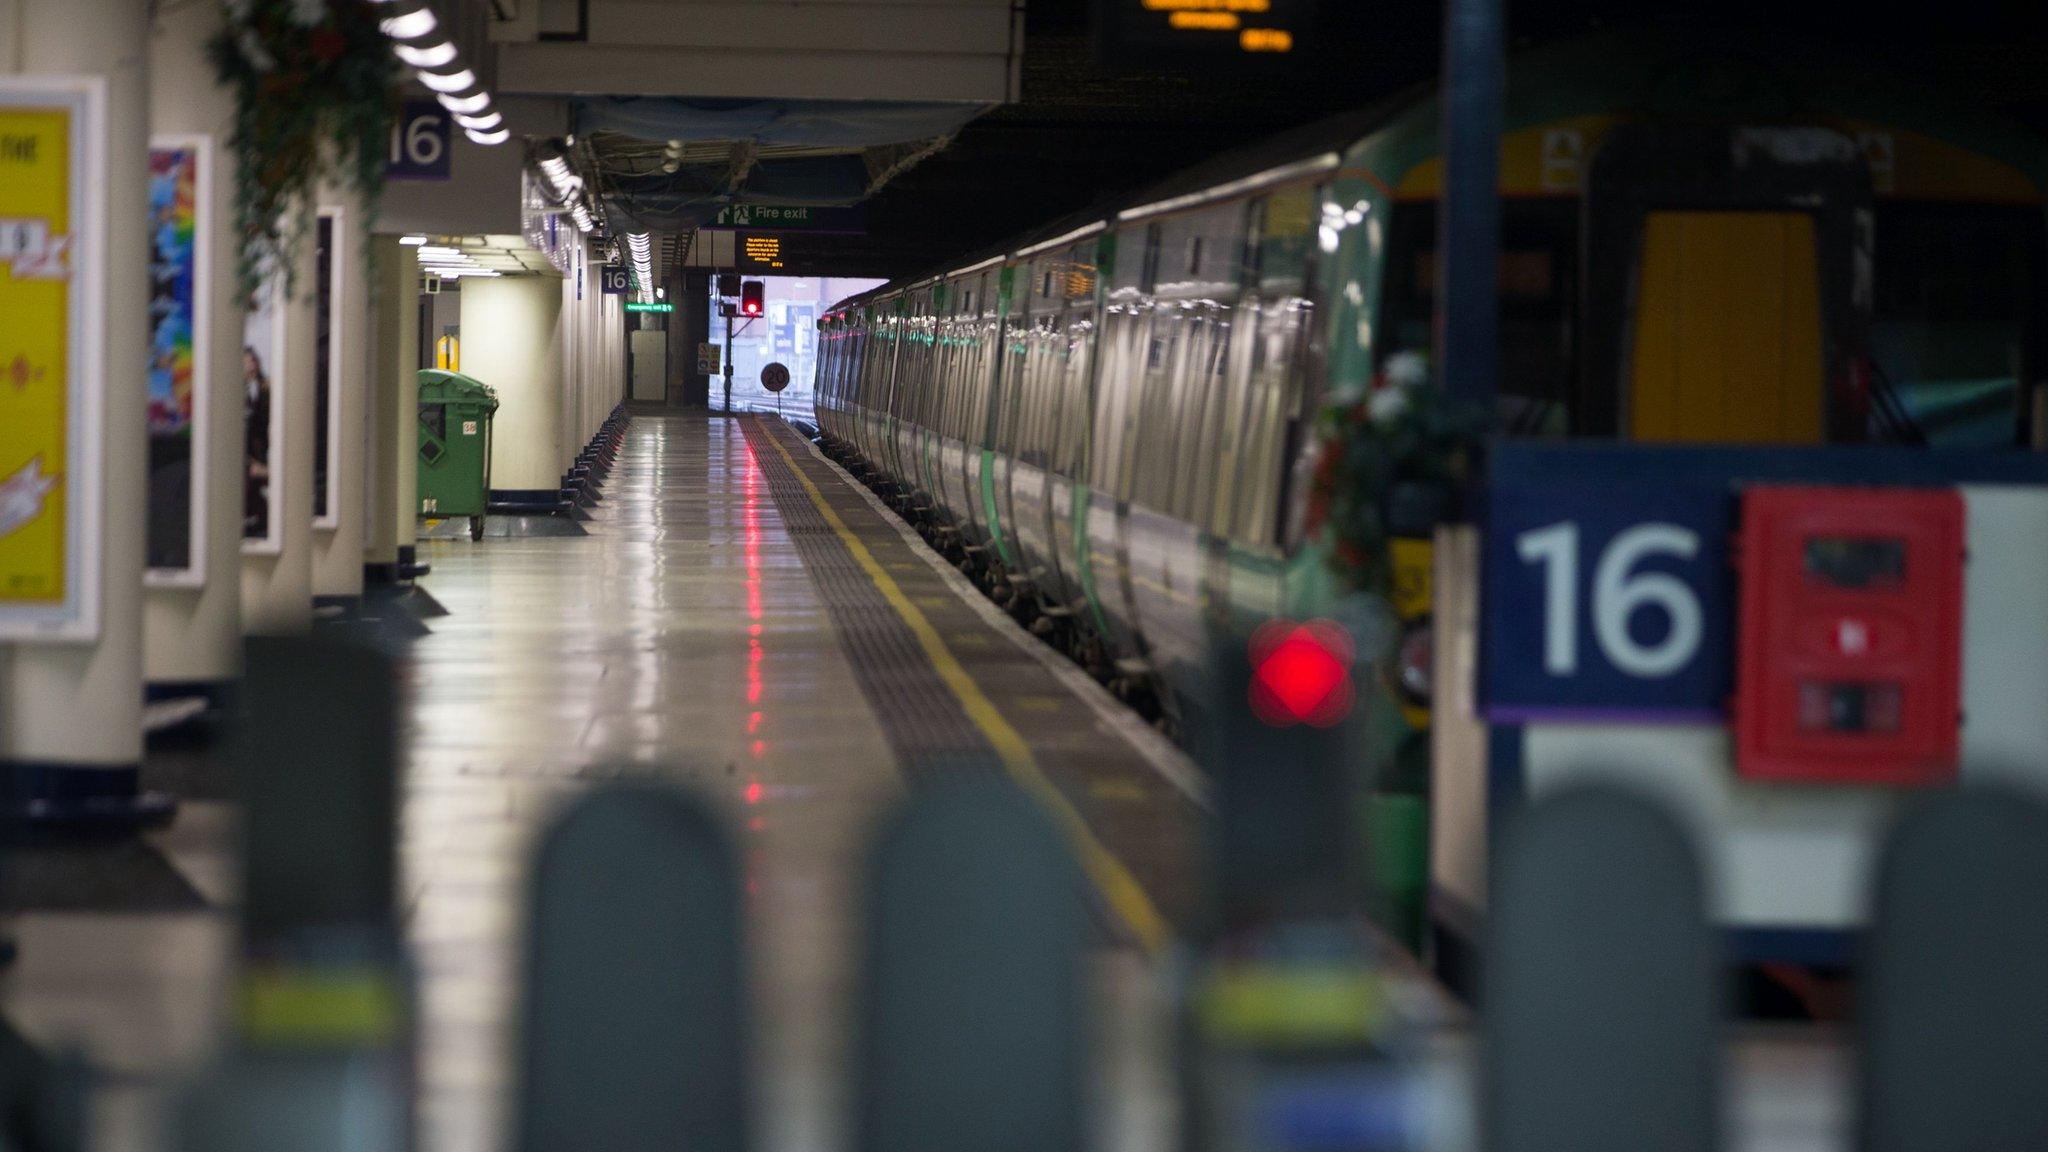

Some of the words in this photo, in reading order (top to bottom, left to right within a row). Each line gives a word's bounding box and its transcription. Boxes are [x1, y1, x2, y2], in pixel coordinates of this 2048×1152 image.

[388, 114, 443, 164] 16
[756, 206, 779, 219] Fire
[783, 207, 808, 219] exit
[605, 271, 626, 289] 16
[767, 370, 786, 385] 20
[1516, 520, 1705, 680] 16
